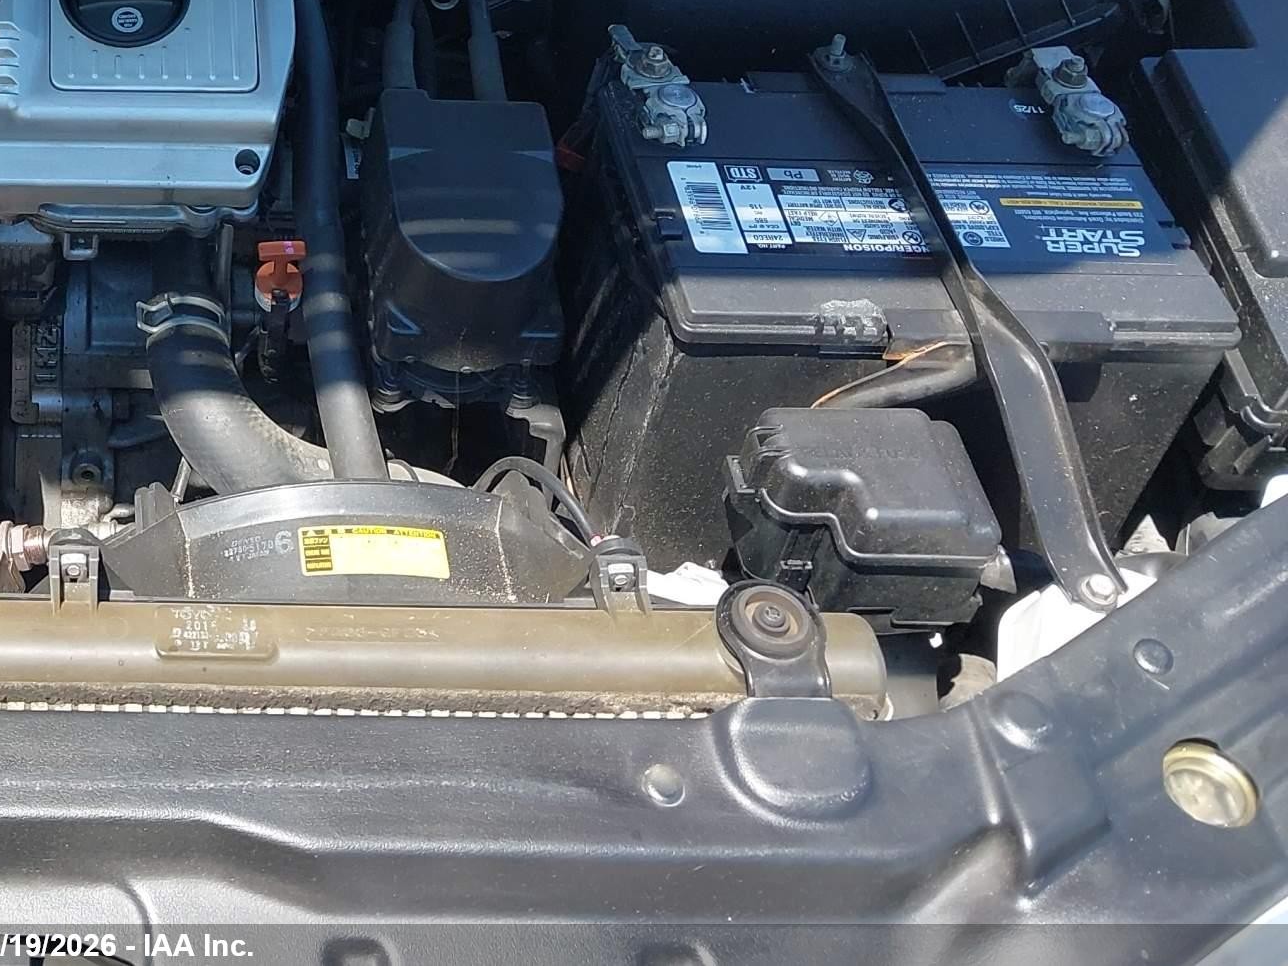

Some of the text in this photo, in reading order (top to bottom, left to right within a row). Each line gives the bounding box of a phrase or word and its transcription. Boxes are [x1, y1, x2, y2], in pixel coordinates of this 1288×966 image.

[729, 167, 757, 179] STD
[784, 170, 803, 179] Pb
[1042, 228, 1145, 245] START
[1047, 241, 1142, 257] SUPER
